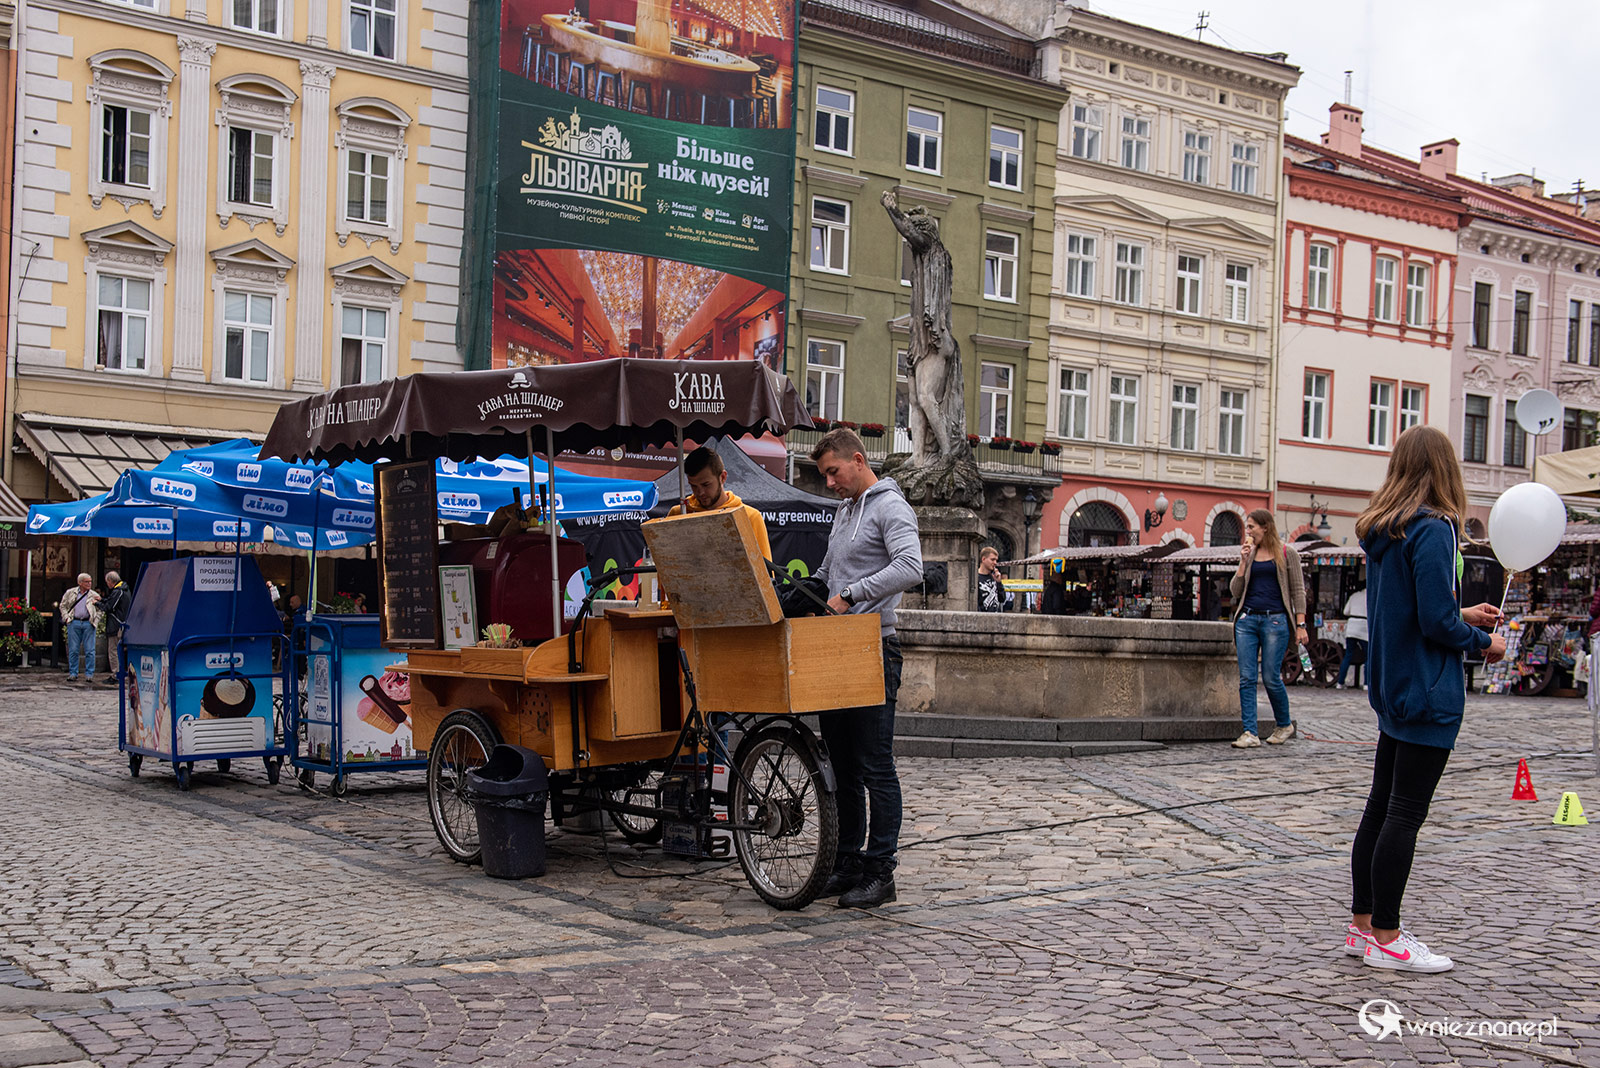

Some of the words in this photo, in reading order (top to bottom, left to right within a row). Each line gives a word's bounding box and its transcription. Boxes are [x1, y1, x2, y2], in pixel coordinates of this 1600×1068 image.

[676, 136, 754, 171] Більше
[521, 153, 647, 202] ЛЬВІВАРНЯ
[658, 159, 697, 185] ніж
[700, 170, 770, 198] музей!
[526, 198, 605, 216] МУЗЕЙНО-КУЛЬТУРНИЙ
[605, 210, 641, 222] КОМПЛЕКС
[671, 201, 698, 212] Мелодії
[671, 209, 696, 218] вулиць
[714, 208, 730, 218] Кіно
[559, 211, 586, 222] ПИВНОЇ
[586, 215, 610, 225] ІСТОРІЇ
[752, 215, 765, 225] Арт
[669, 372, 726, 409] КАВА
[326, 402, 345, 425] НА
[477, 395, 505, 421] КАВА
[503, 392, 520, 407] НА
[519, 391, 564, 412] ШПАЦЕР
[680, 401, 692, 413] НА
[693, 401, 726, 415] ШПАЦЕР
[153, 480, 193, 498] лімо
[246, 497, 285, 513] лімо
[442, 493, 478, 508] лімо
[607, 493, 642, 505] лімо
[335, 510, 373, 525] лімо
